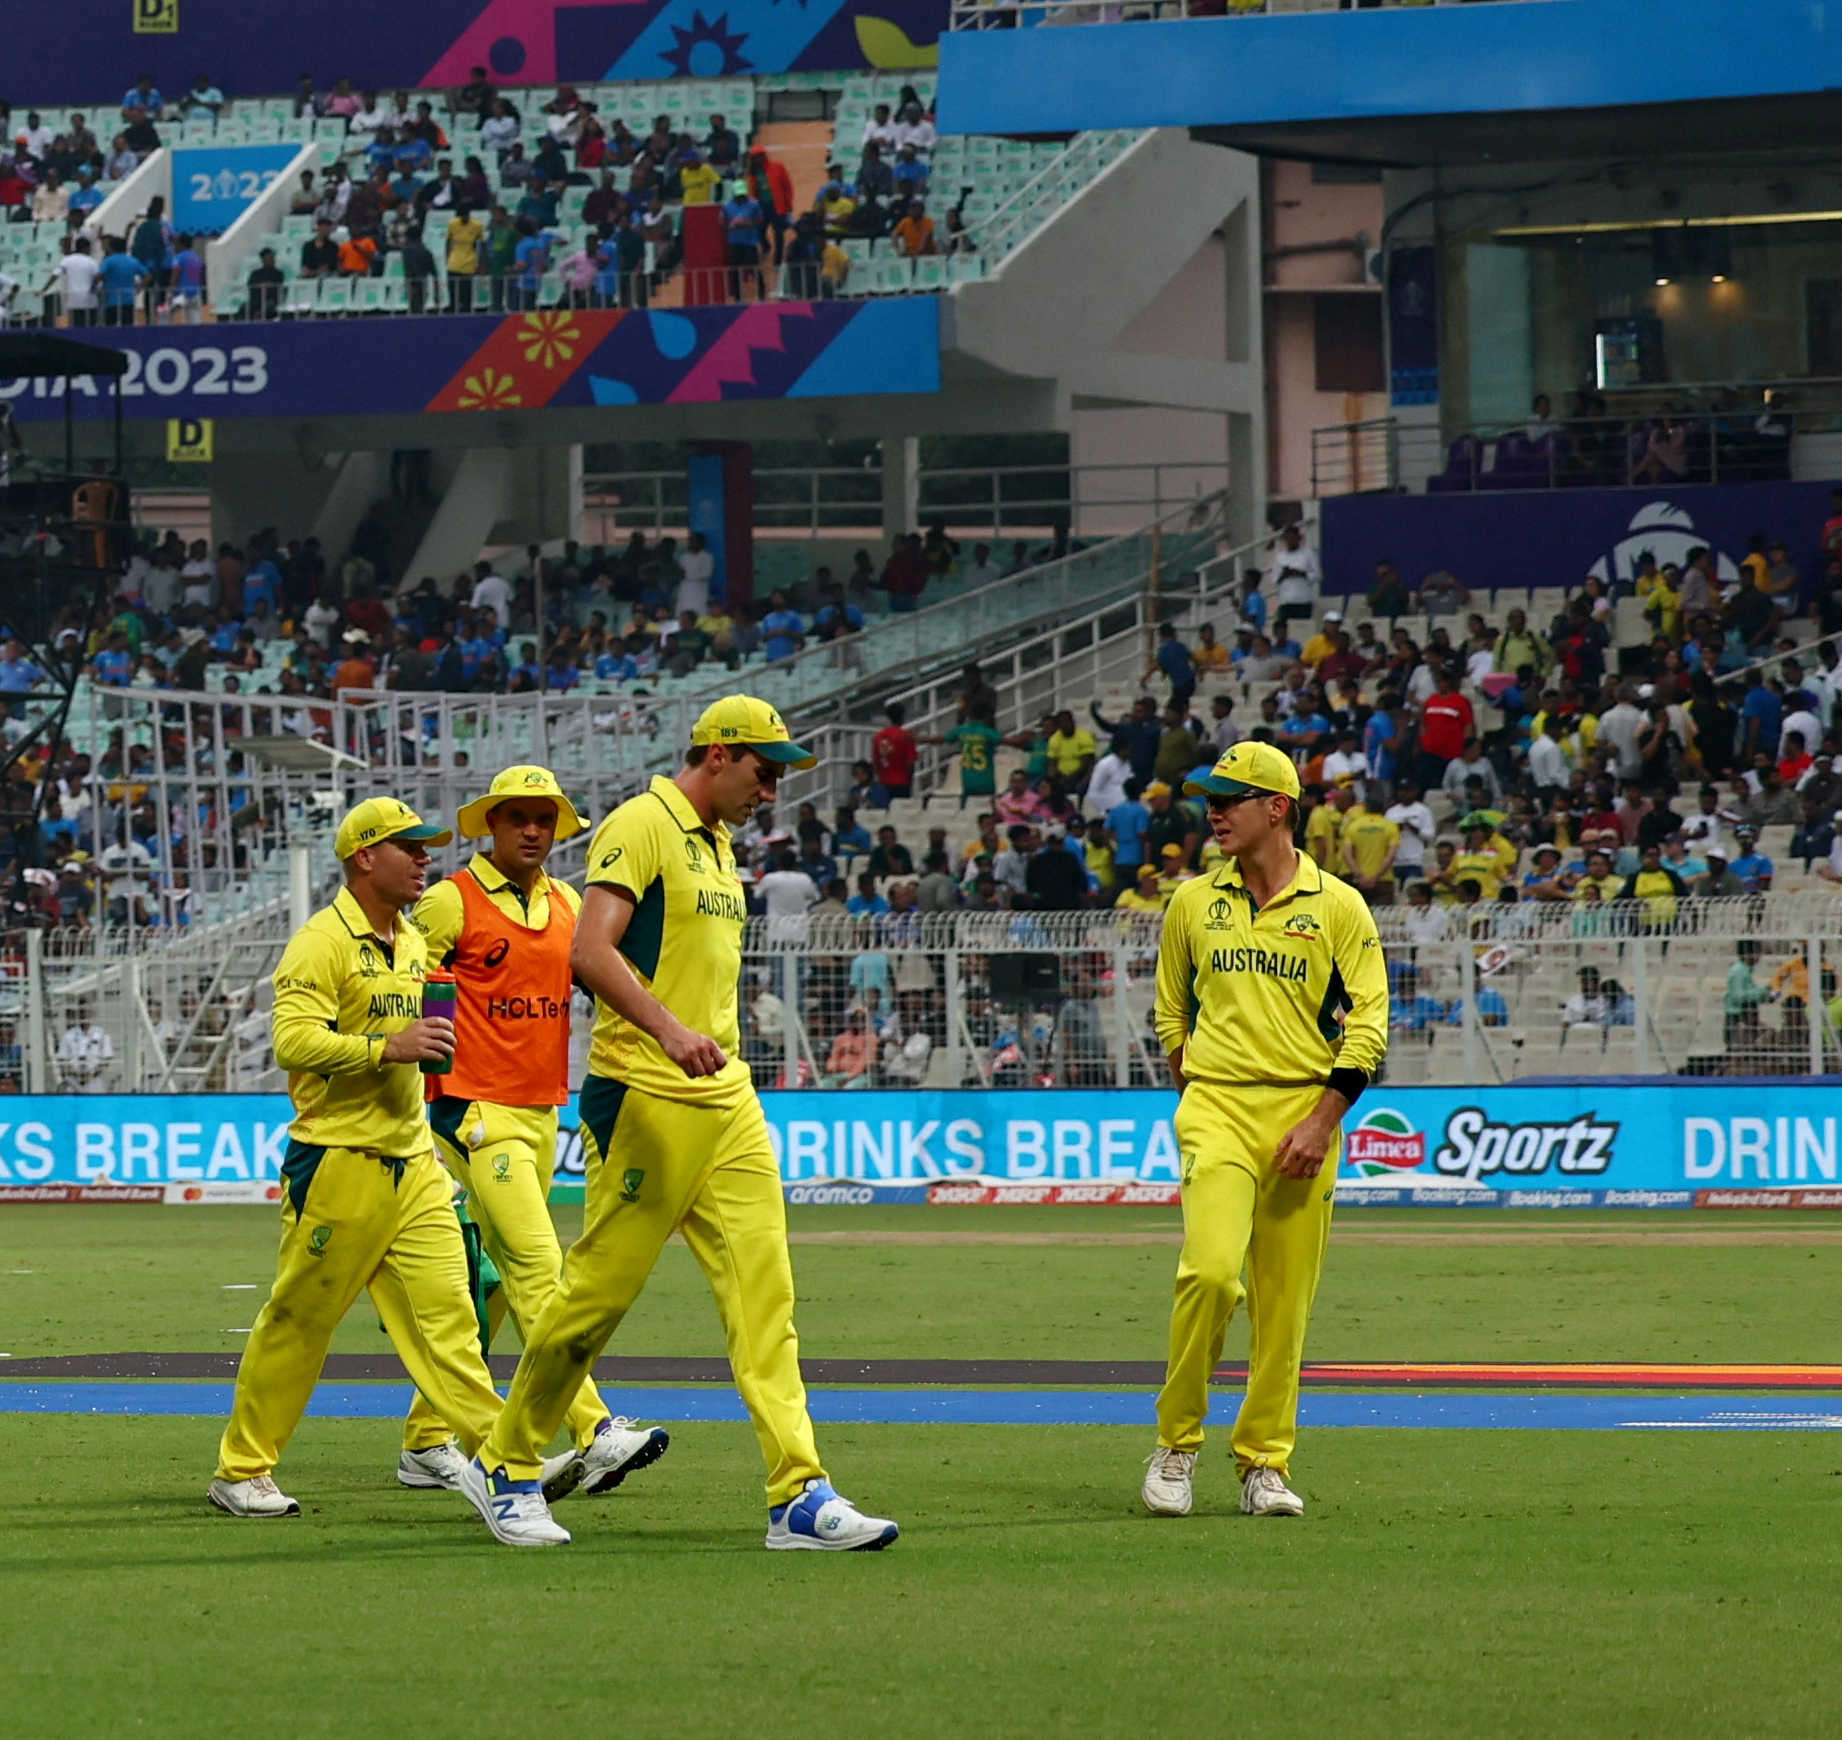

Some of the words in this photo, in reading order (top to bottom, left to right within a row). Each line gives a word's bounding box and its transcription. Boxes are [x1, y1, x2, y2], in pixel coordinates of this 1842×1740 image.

[108, 346, 268, 397] 2023
[180, 417, 203, 447] D
[721, 727, 738, 738] 189
[359, 828, 376, 841] 170
[696, 888, 744, 922] AUSTRAL
[1211, 948, 1307, 983] AUSTRALIA
[367, 993, 421, 1019] AUSTRAL
[76, 1122, 288, 1180] BREAK
[1006, 1117, 1180, 1179] BREA
[1348, 1134, 1422, 1159] Limca
[1437, 1110, 1618, 1180] Sportz
[789, 1186, 874, 1202] aramco
[928, 1186, 987, 1202] MRF
[991, 1186, 1051, 1202] MRF
[1055, 1186, 1115, 1202] MRF
[1119, 1186, 1174, 1202] MRF
[1411, 1188, 1496, 1203] Booking.com
[1604, 1189, 1690, 1205] Booking.com
